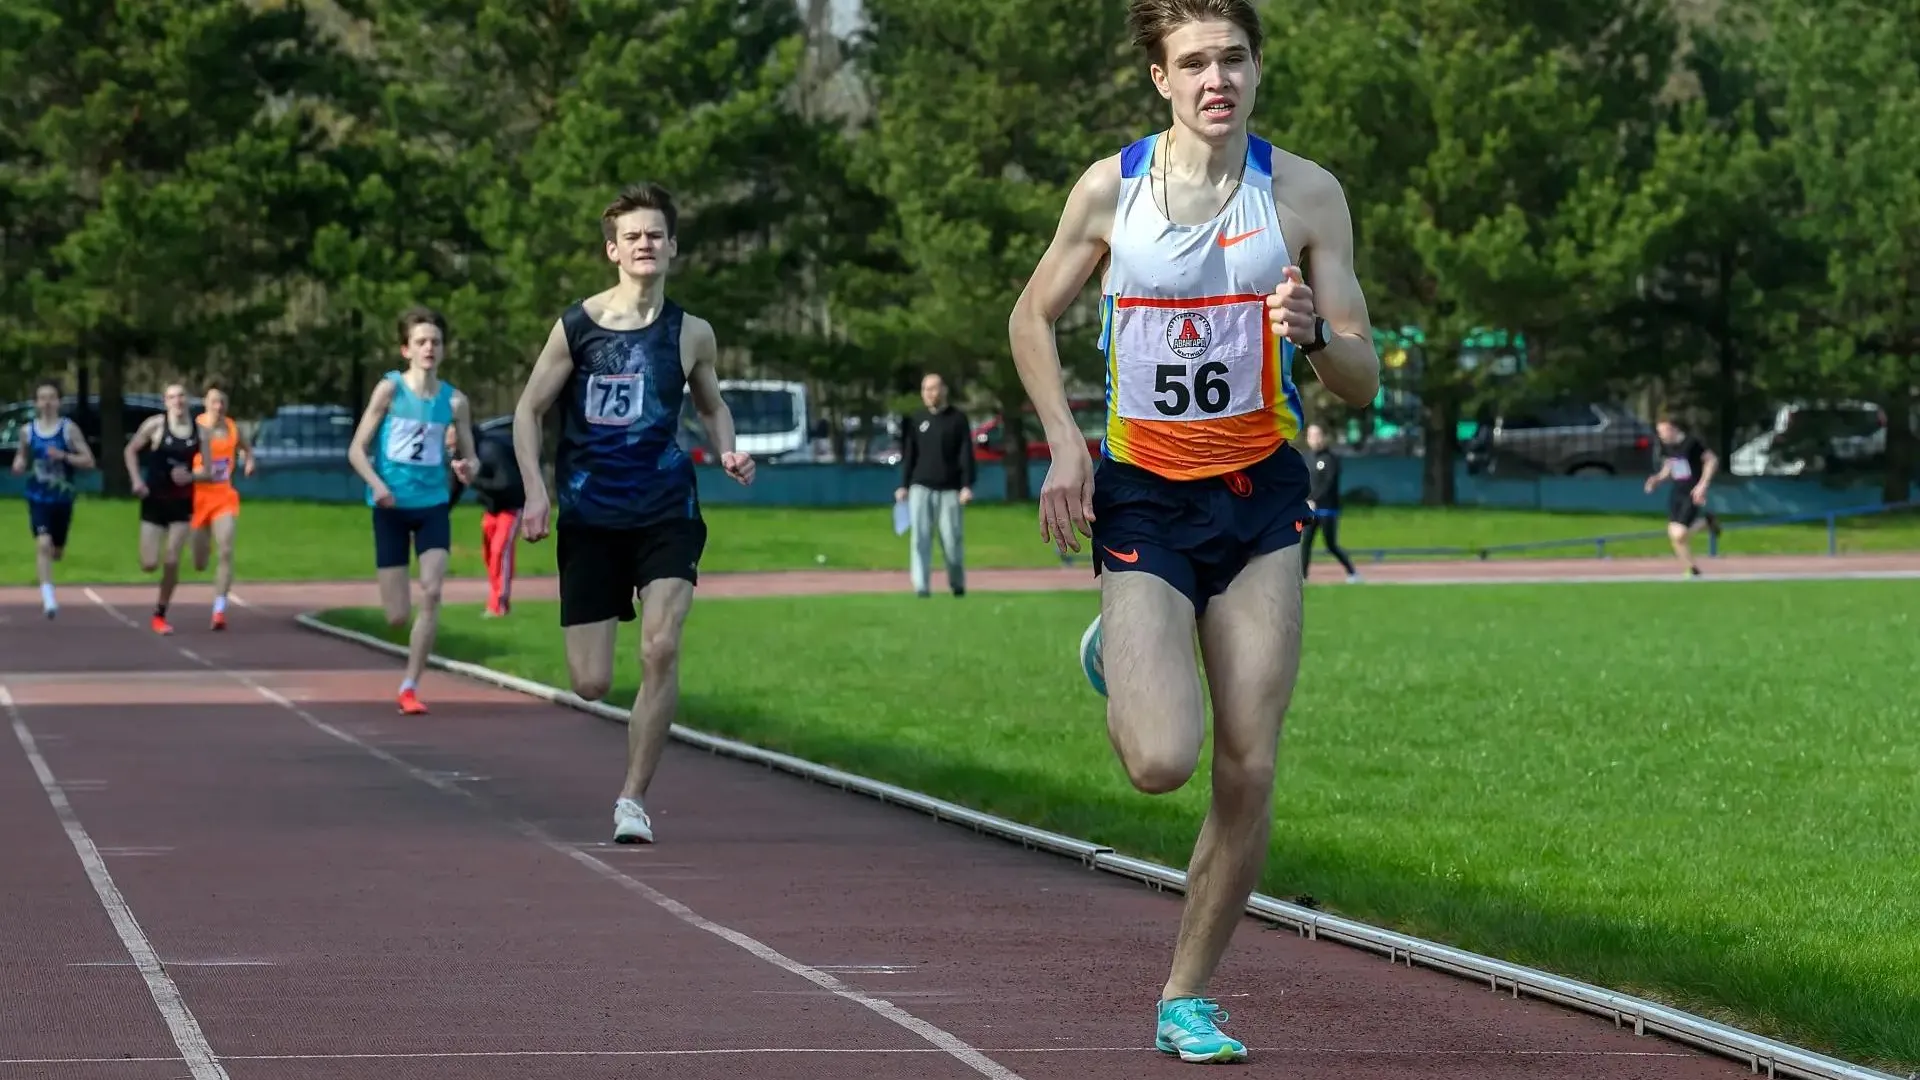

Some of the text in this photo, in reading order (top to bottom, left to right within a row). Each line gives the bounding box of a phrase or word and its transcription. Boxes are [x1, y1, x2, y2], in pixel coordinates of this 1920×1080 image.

[596, 382, 631, 418] 75
[1153, 361, 1231, 416] 56
[410, 442, 424, 461] 2
